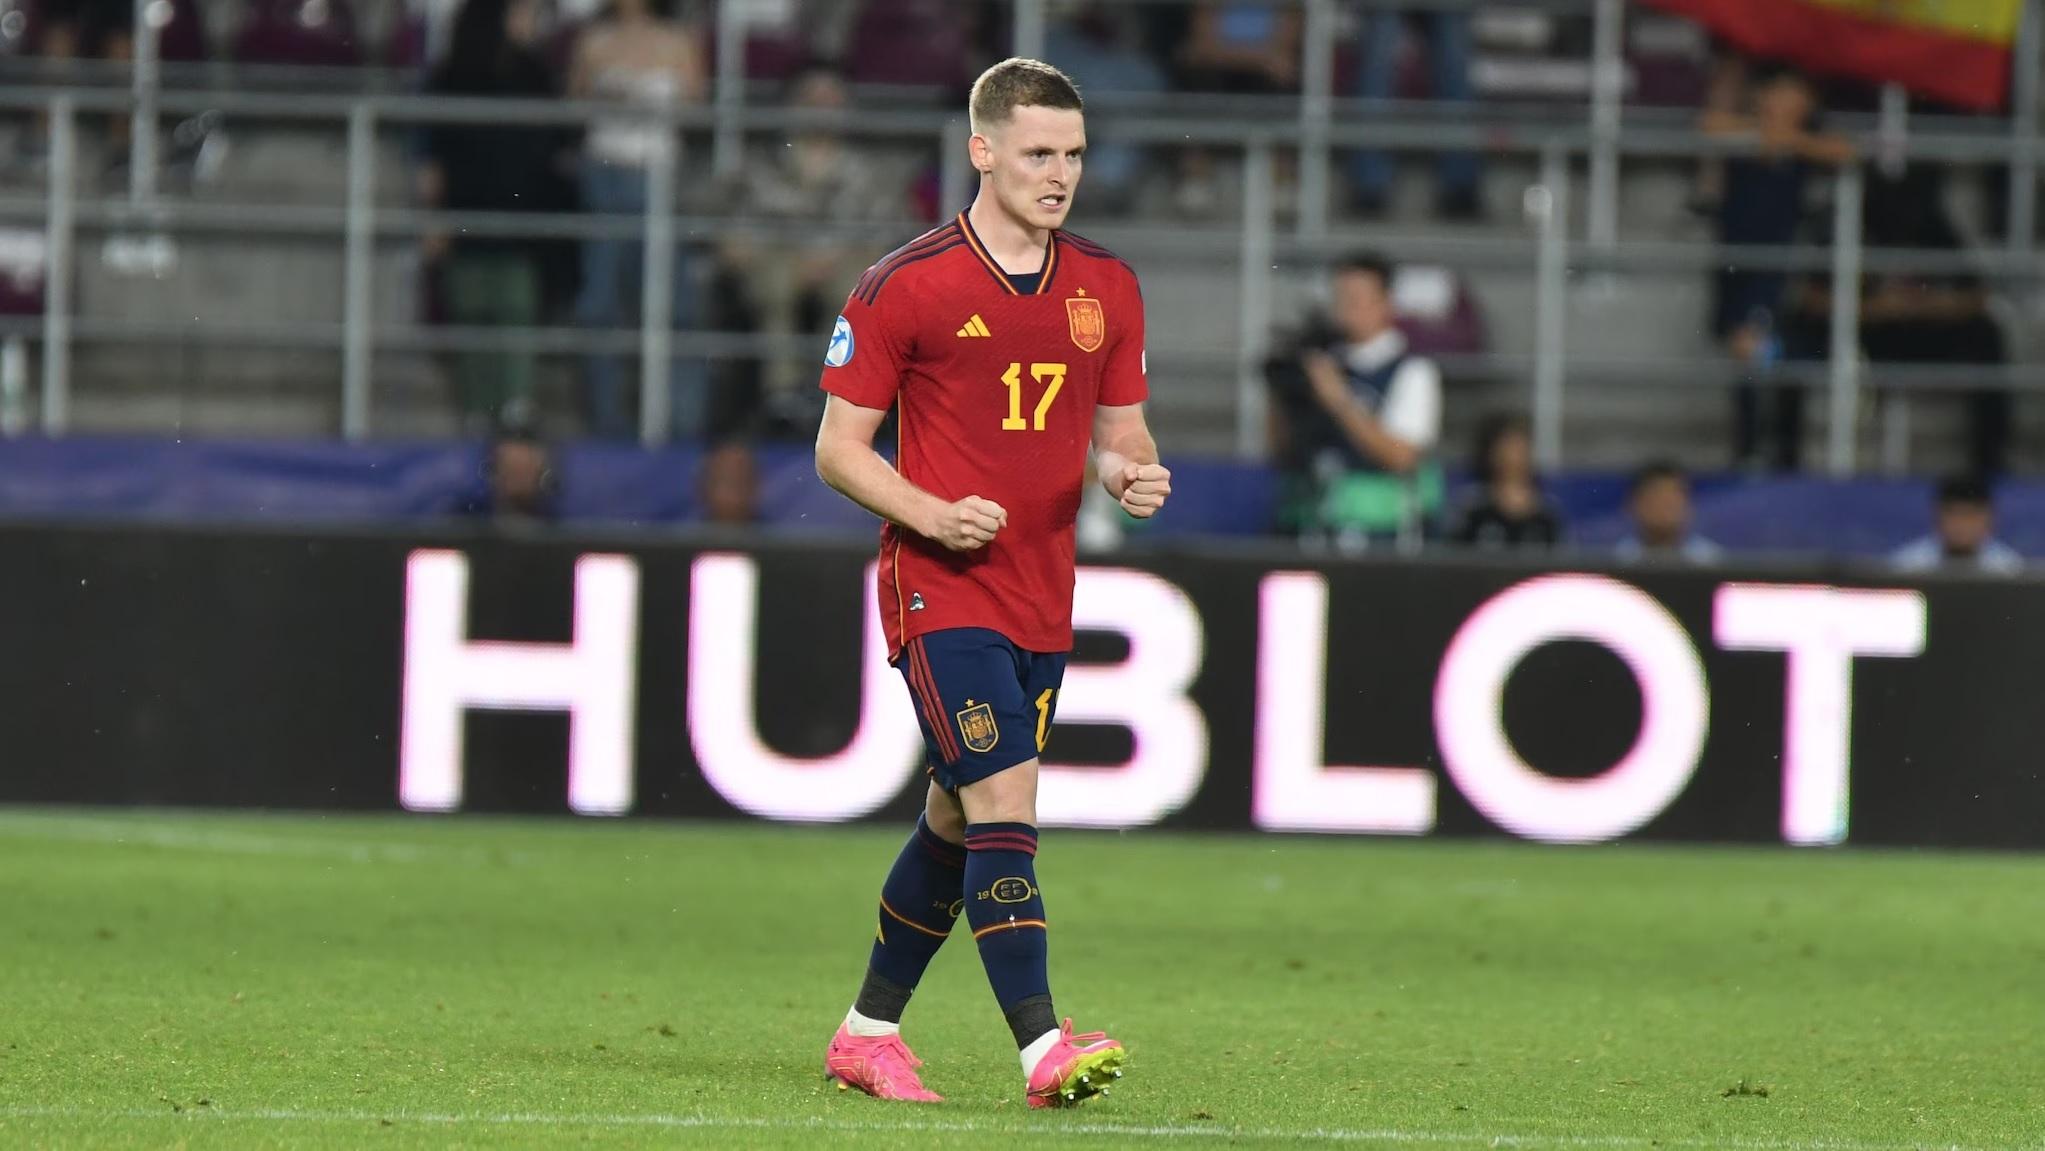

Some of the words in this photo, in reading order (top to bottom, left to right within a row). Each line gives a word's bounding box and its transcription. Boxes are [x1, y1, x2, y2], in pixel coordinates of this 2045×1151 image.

[1000, 362, 1067, 431] 17
[400, 547, 1928, 847] HUBLOT
[1034, 687, 1060, 753] 1
